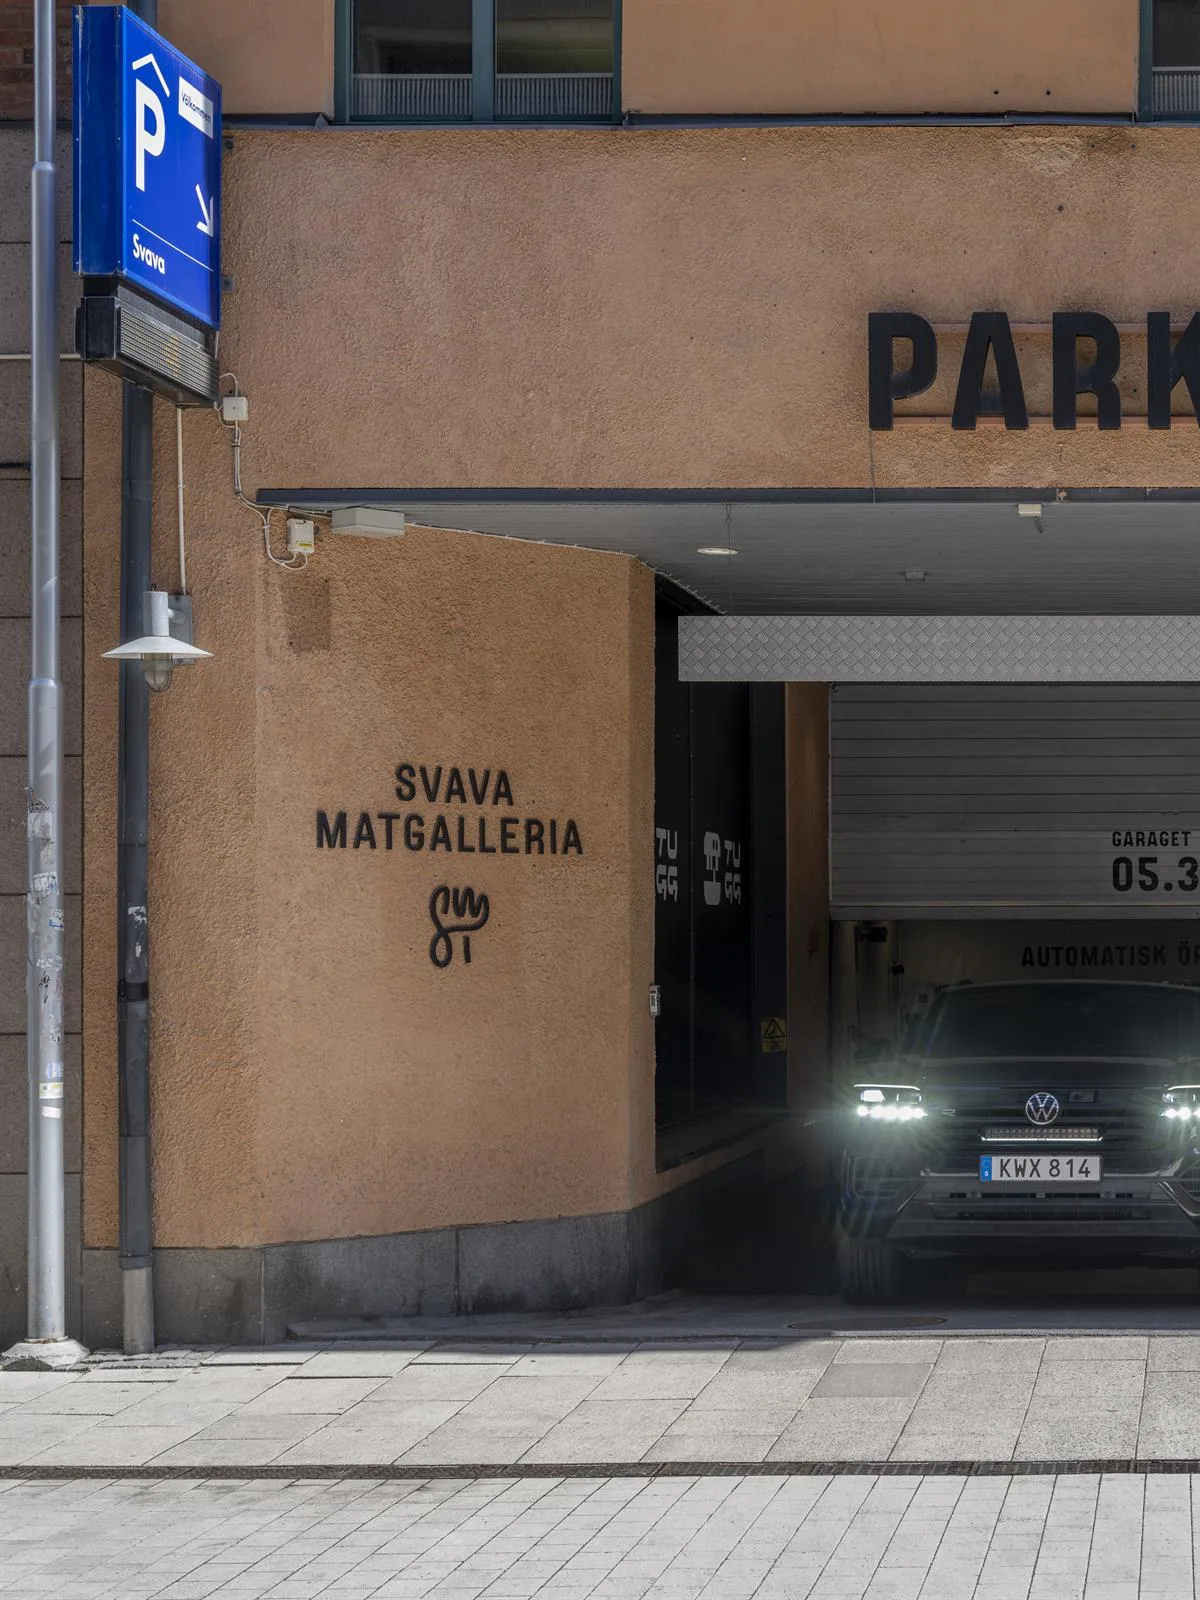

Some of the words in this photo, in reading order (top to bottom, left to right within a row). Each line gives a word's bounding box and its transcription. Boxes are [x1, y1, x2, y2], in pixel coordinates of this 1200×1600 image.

[180, 90, 213, 122] Välkommen
[135, 78, 166, 192] P
[132, 233, 166, 275] Svava
[395, 763, 514, 806] SVAVA
[316, 810, 583, 855] MATGALLERIA
[1112, 830, 1192, 847] GARAGET
[1021, 945, 1166, 968] AUTOMATISK
[1000, 1159, 1041, 1178] KWX
[1049, 1159, 1091, 1178] 814
